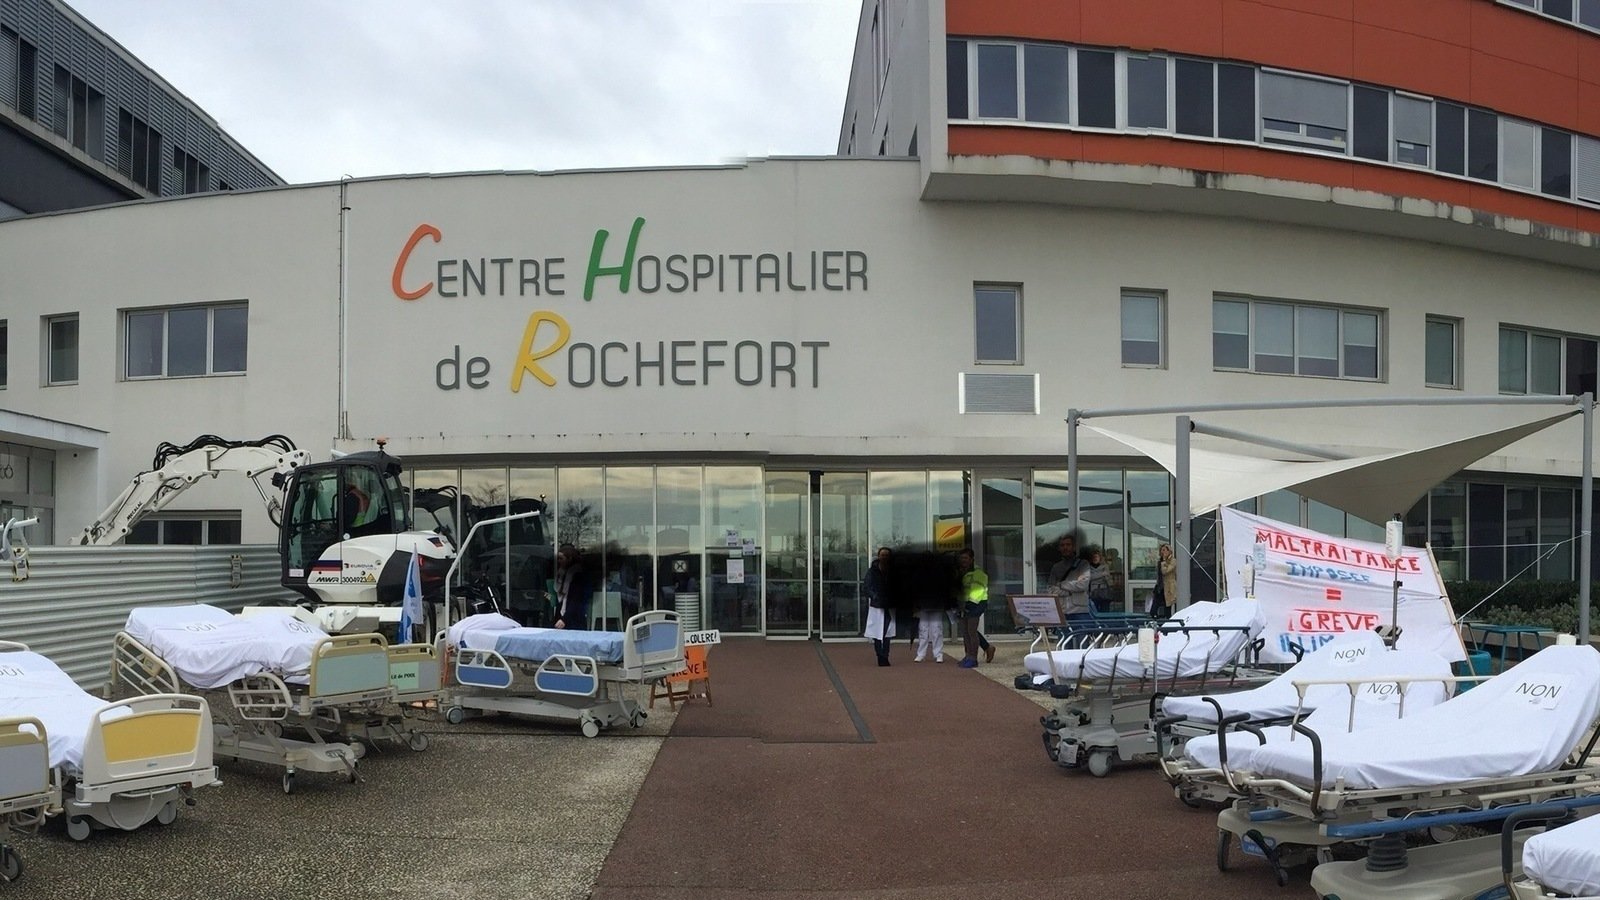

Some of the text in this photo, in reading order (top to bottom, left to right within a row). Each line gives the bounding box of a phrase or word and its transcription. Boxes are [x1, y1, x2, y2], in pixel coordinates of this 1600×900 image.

[391, 217, 869, 301] CENTRE HOSPITALIER
[435, 310, 831, 393] de ROCHEFORT
[1255, 530, 1421, 571] MALTRAITANCE
[186, 623, 217, 633] OUI
[1334, 647, 1366, 660] NON
[1367, 682, 1401, 696] NON
[1515, 682, 1562, 698] NON
